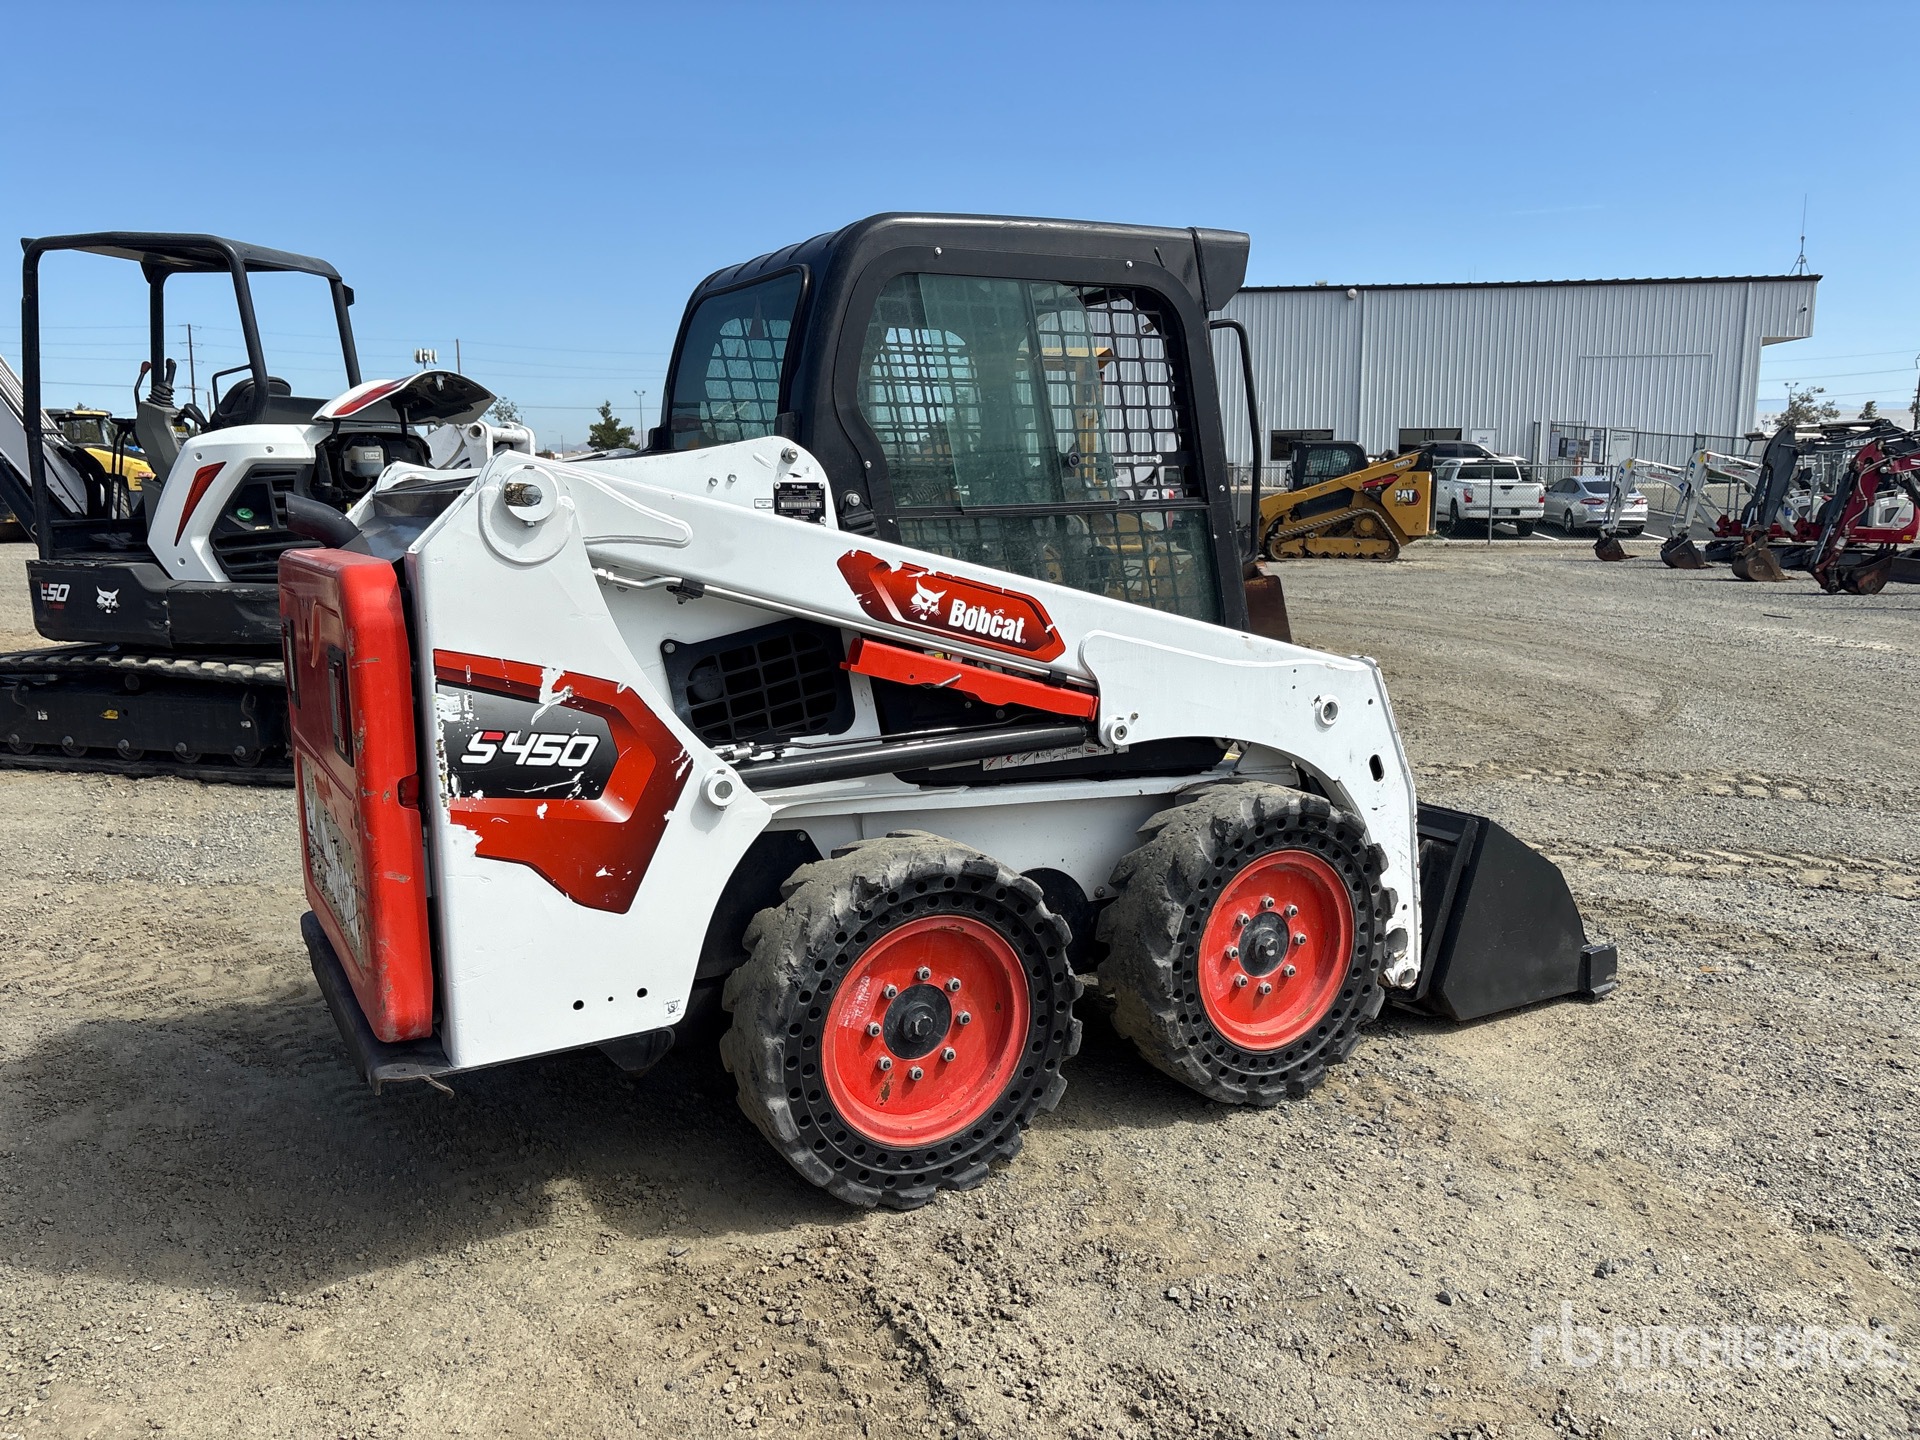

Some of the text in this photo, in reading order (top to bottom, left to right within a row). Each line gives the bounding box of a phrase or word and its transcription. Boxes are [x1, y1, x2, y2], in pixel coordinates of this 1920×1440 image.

[1395, 489, 1415, 502] CAT
[948, 598, 1025, 643] Bobcat
[461, 731, 599, 767] S450
